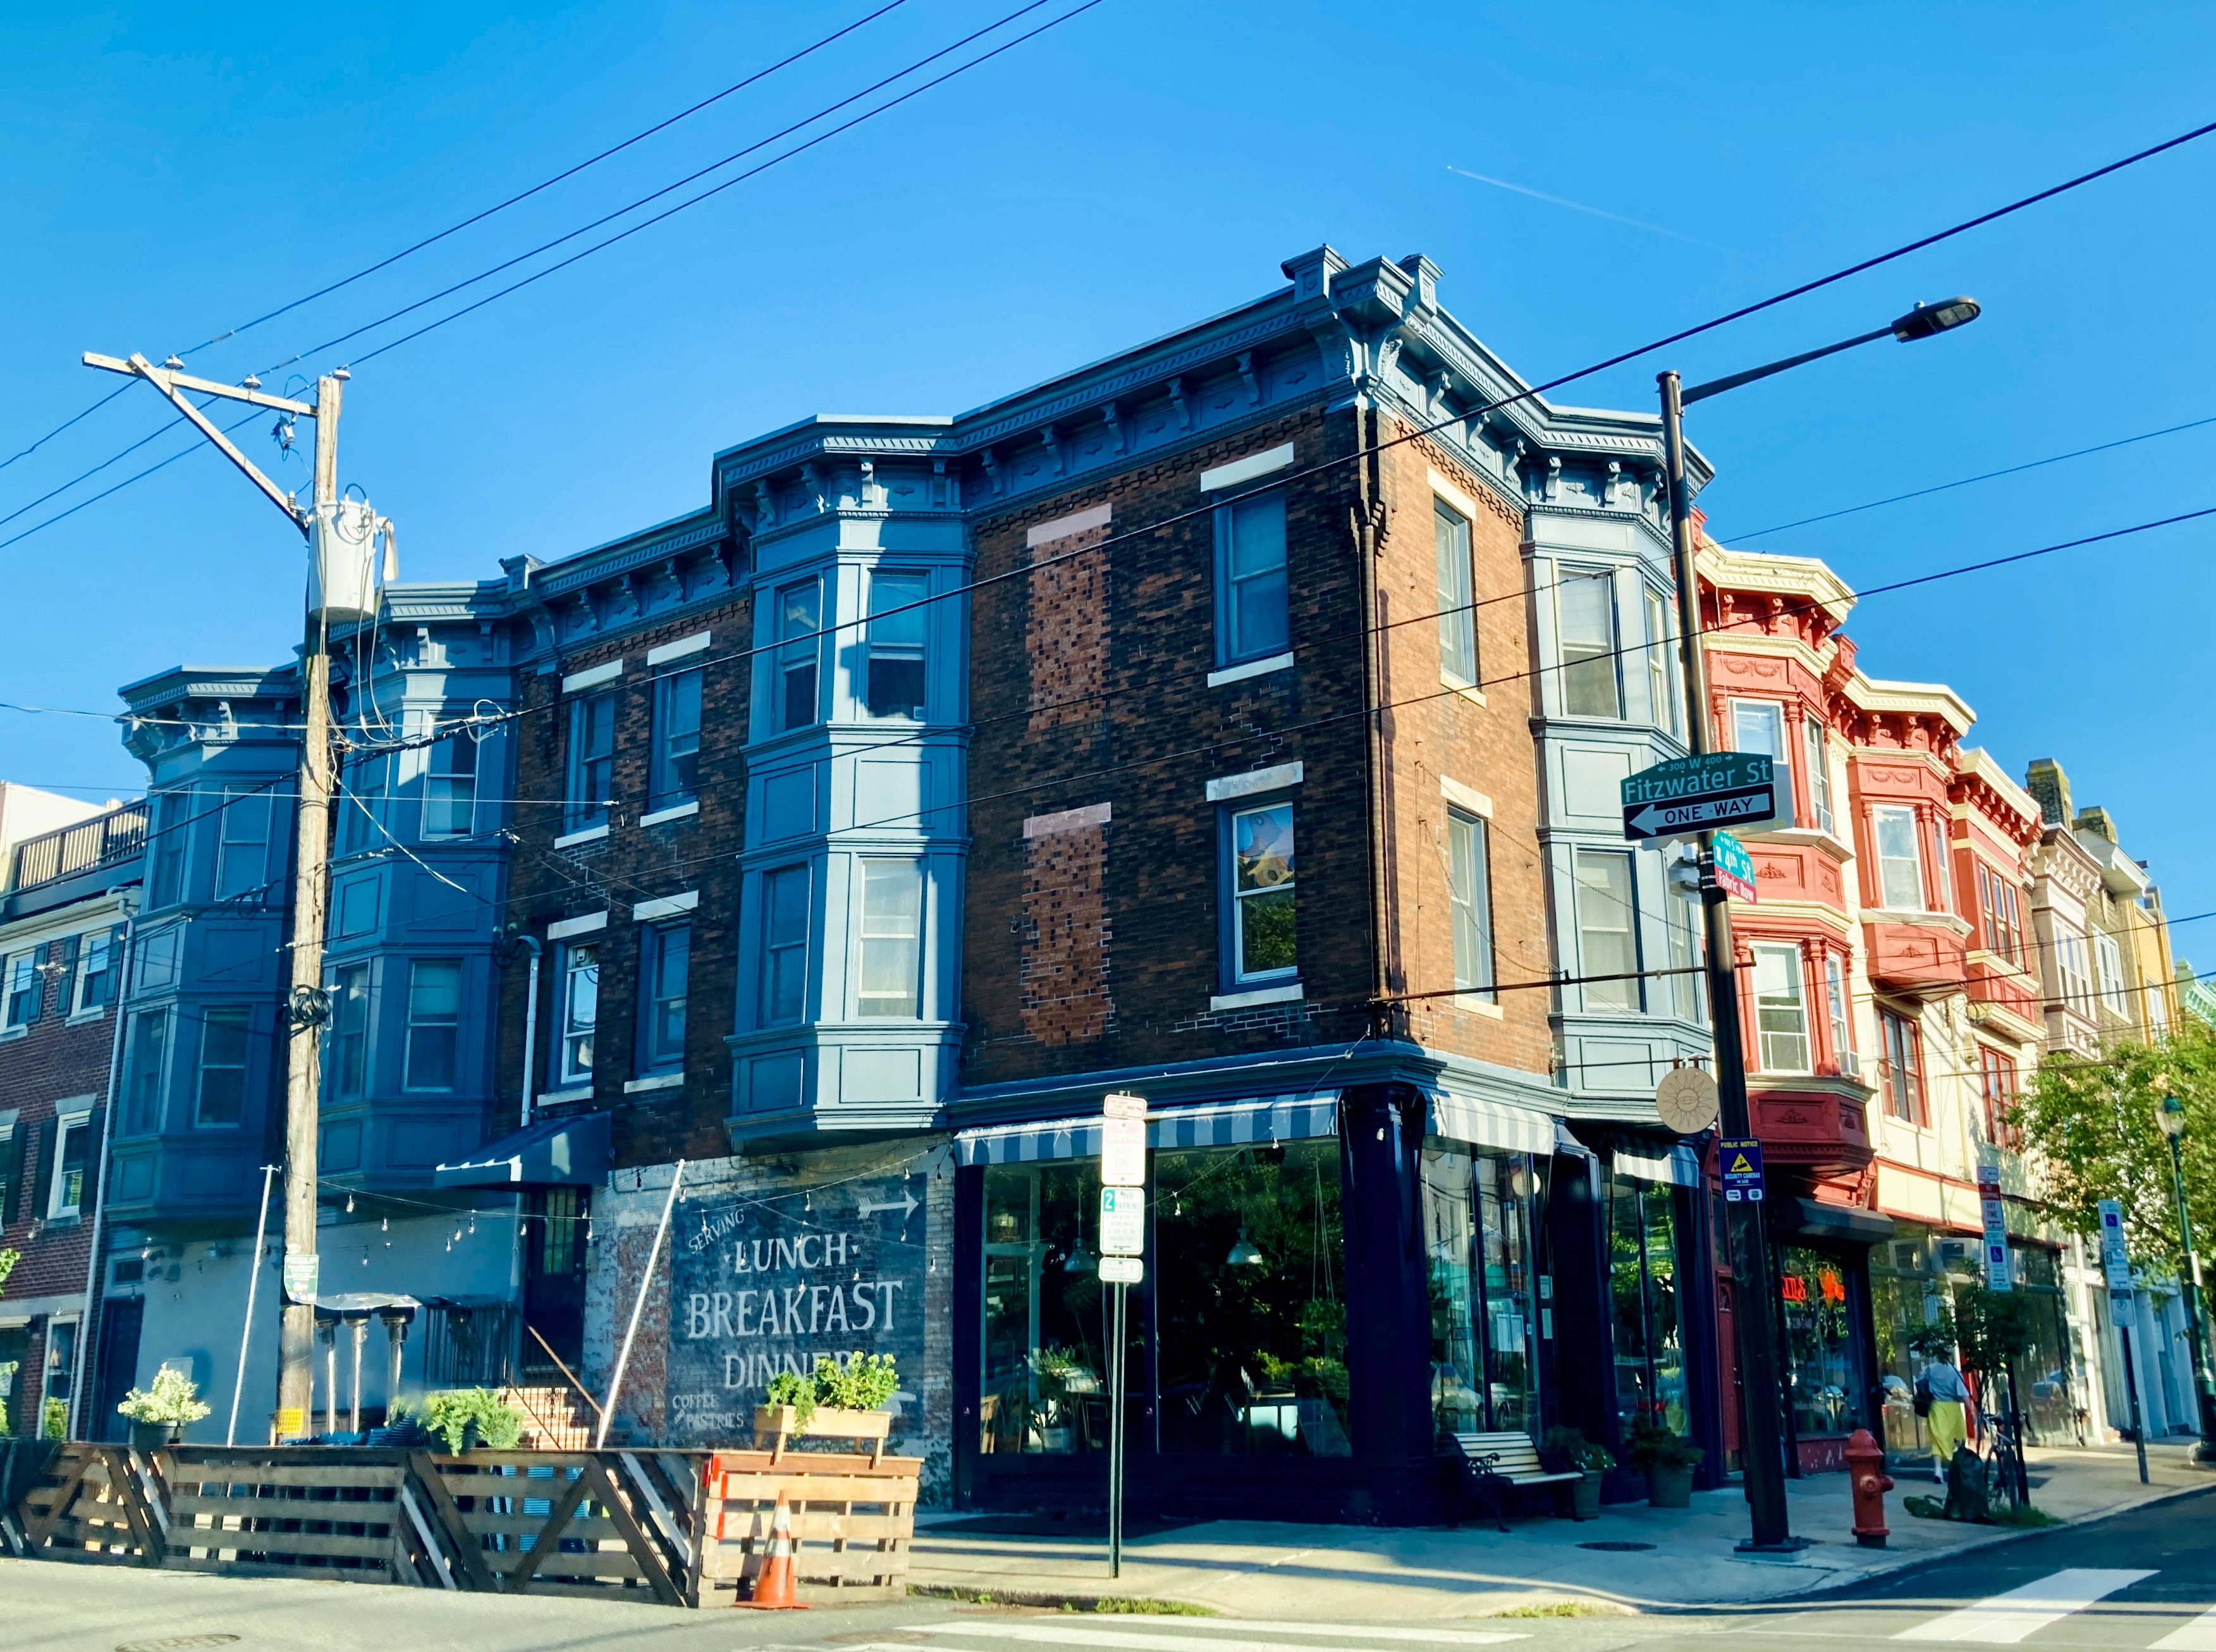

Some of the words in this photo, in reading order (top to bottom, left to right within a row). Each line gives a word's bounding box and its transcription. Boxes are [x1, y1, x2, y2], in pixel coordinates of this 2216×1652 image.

[1669, 762, 1686, 771] 300
[1689, 757, 1701, 769] W
[1705, 756, 1722, 765] 400
[1625, 768, 1735, 802] Fitzwater
[1746, 760, 1770, 783] St
[1665, 805, 1702, 824] ONE
[1714, 797, 1753, 816] WAY
[1731, 840, 1735, 852] S
[1725, 850, 1737, 871] 4th
[1741, 859, 1752, 883] St
[1718, 870, 1739, 894] Fabric
[1740, 882, 1754, 902] Row
[1115, 1146, 1132, 1156] ANY
[1115, 1158, 1133, 1168] TIME
[1105, 1192, 1113, 1209] 2
[1123, 1192, 1134, 1200] HR
[1116, 1201, 1141, 1210] PARKING
[687, 1208, 745, 1254] SERVING
[734, 1233, 848, 1274] LUNCH
[1130, 1266, 1134, 1274] 7
[687, 1280, 903, 1339] BREAKFAST
[672, 1394, 719, 1409] COFFEE
[687, 1412, 745, 1429] PASTRIES
